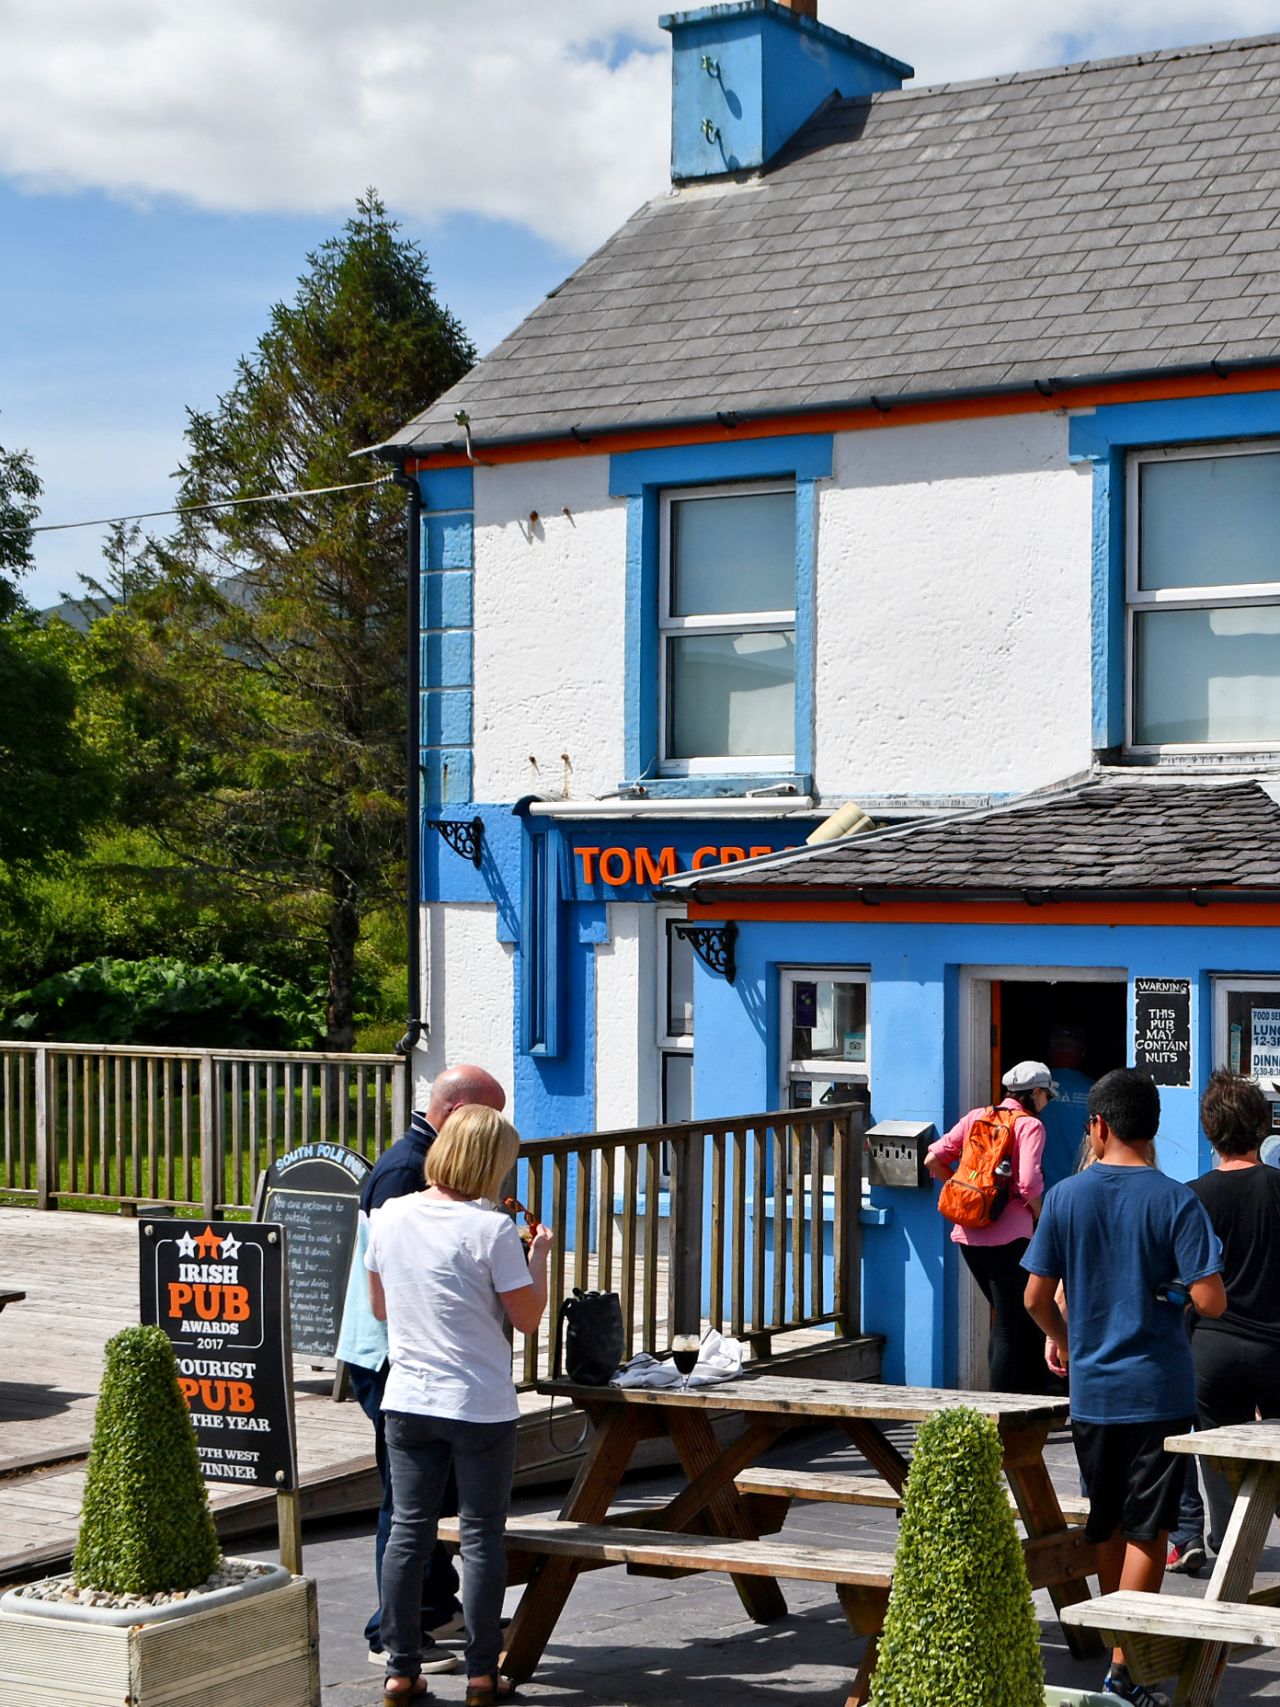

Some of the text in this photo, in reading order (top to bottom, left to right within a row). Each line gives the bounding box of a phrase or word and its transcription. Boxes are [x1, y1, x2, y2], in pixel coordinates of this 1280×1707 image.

[574, 846, 677, 885] TOM
[1138, 981, 1188, 993] WARNING
[1148, 1009, 1176, 1019] THIS
[1253, 1011, 1270, 1021] FOOD
[1150, 1019, 1174, 1030] PUB
[1146, 1029, 1176, 1040] MAY
[1136, 1040, 1188, 1051] CONTAIN
[1145, 1052, 1178, 1064] NUTS
[276, 1143, 366, 1180] SOUTH POLE INN
[302, 1202, 333, 1212] welcome
[336, 1202, 344, 1212] to
[285, 1211, 311, 1224] outside
[311, 1247, 331, 1256] drink
[179, 1263, 239, 1284] IRISH
[168, 1282, 251, 1322] PUB
[181, 1320, 240, 1335] AWARDS
[196, 1338, 224, 1350] 2017
[176, 1377, 256, 1413] PUB
[190, 1413, 271, 1432] THE YEAR
[197, 1446, 260, 1462] UTH WEST
